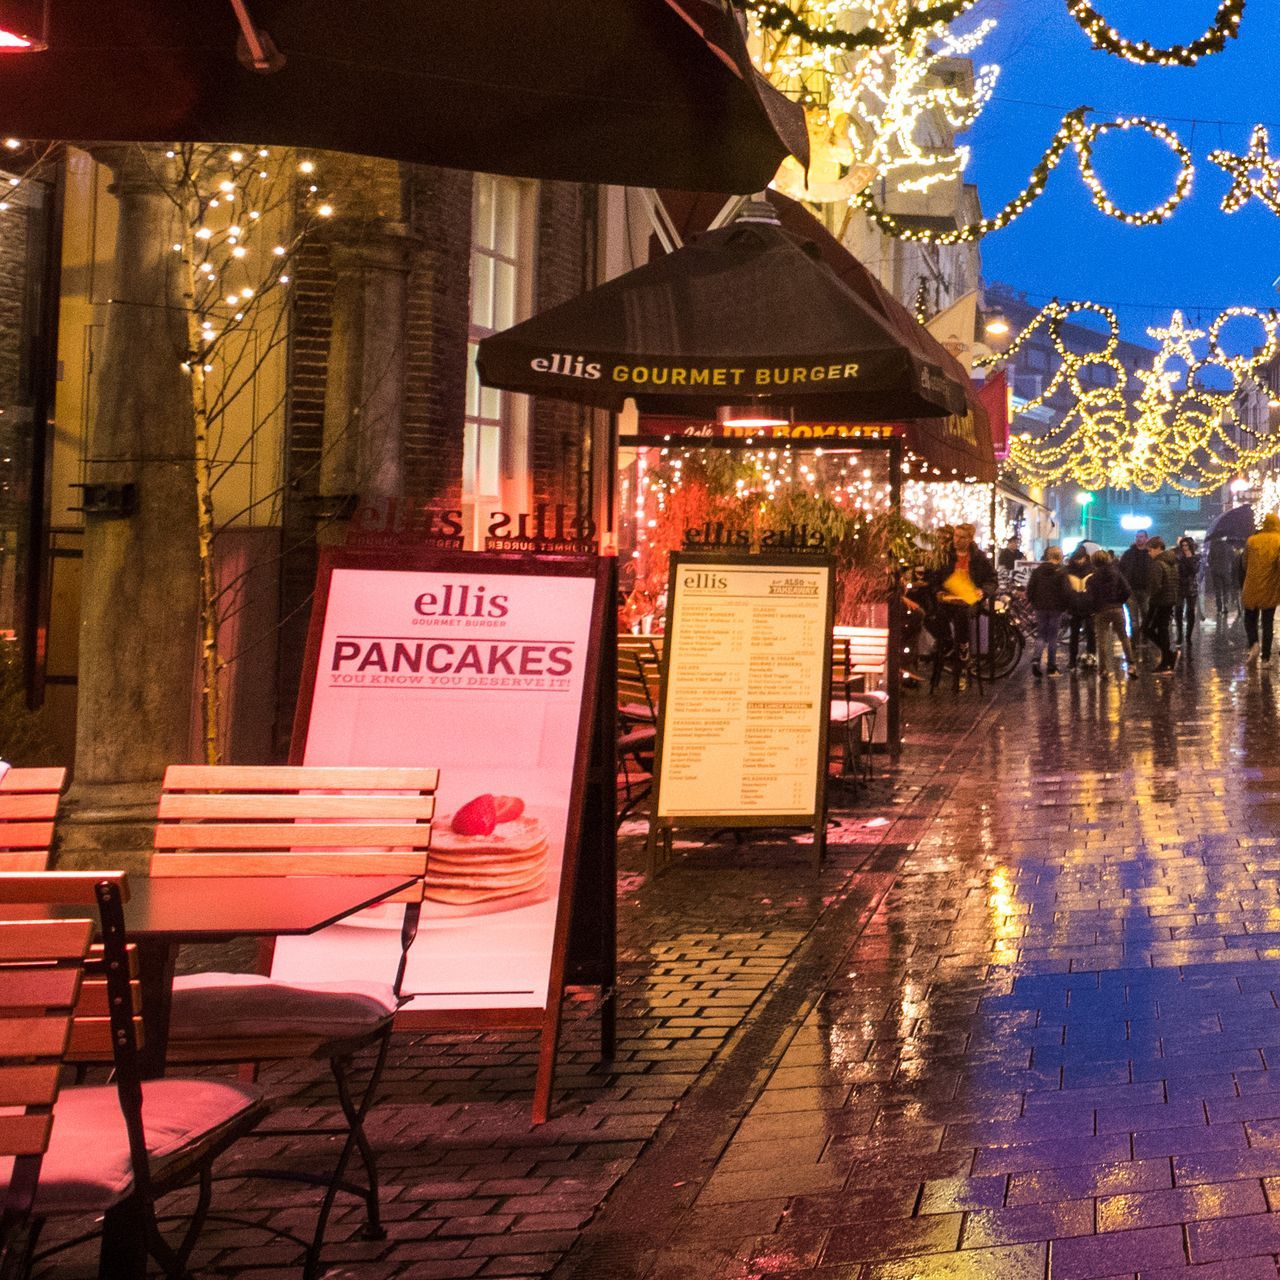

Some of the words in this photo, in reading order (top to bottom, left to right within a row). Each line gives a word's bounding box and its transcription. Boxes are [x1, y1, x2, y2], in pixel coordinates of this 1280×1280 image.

[531, 353, 602, 380] ellis
[613, 365, 745, 386] GOURMET
[755, 363, 860, 385] BURGER
[684, 573, 728, 590] ellis
[414, 584, 509, 618] ellis
[412, 618, 462, 627] GOURMET
[465, 619, 507, 627] BURGER
[332, 641, 573, 676] PANCAKES
[331, 673, 366, 684] YOU
[370, 674, 424, 685] KNOW
[429, 676, 463, 686] YOU
[467, 676, 545, 688] DESERVE
[549, 679, 571, 688] IT!
